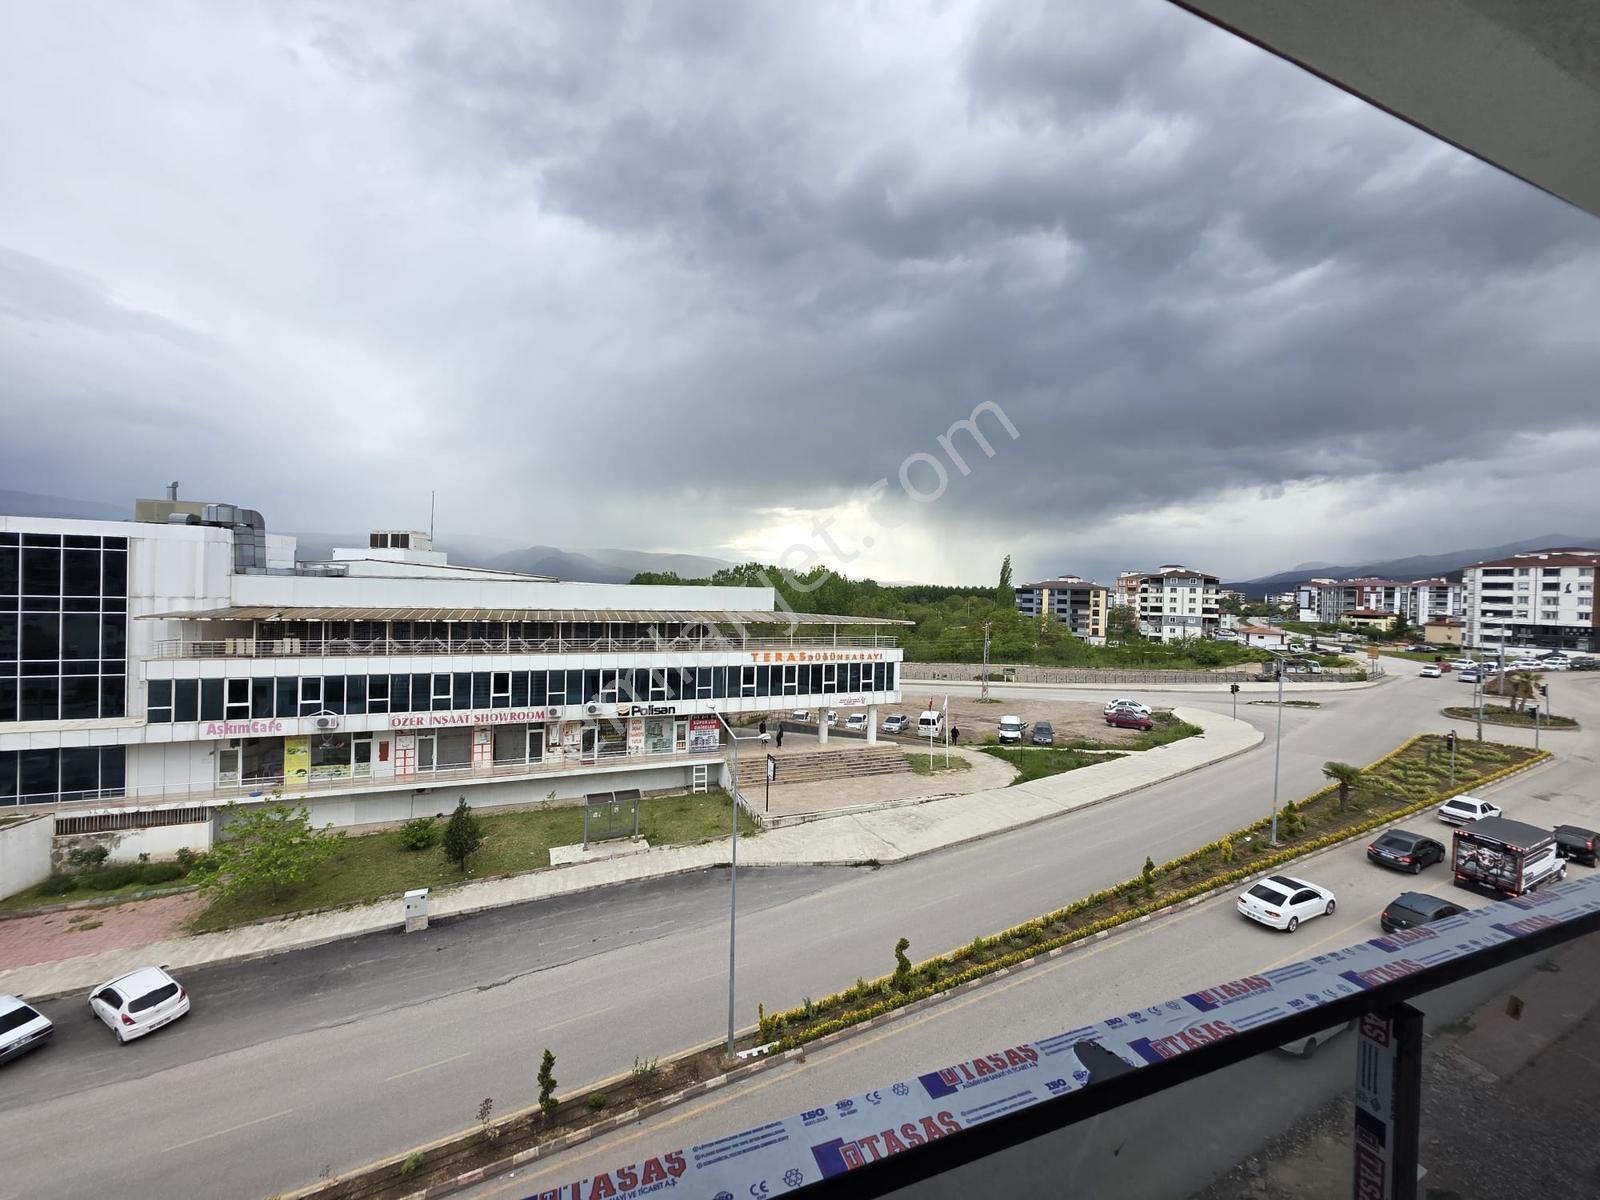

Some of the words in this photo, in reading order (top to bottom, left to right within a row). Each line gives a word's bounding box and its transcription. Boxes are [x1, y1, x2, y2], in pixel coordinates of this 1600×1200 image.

[751, 652, 806, 663] TERAS
[631, 704, 676, 716] Polisan
[474, 710, 545, 723] SHOWROOM
[800, 1108, 825, 1122] ISO
